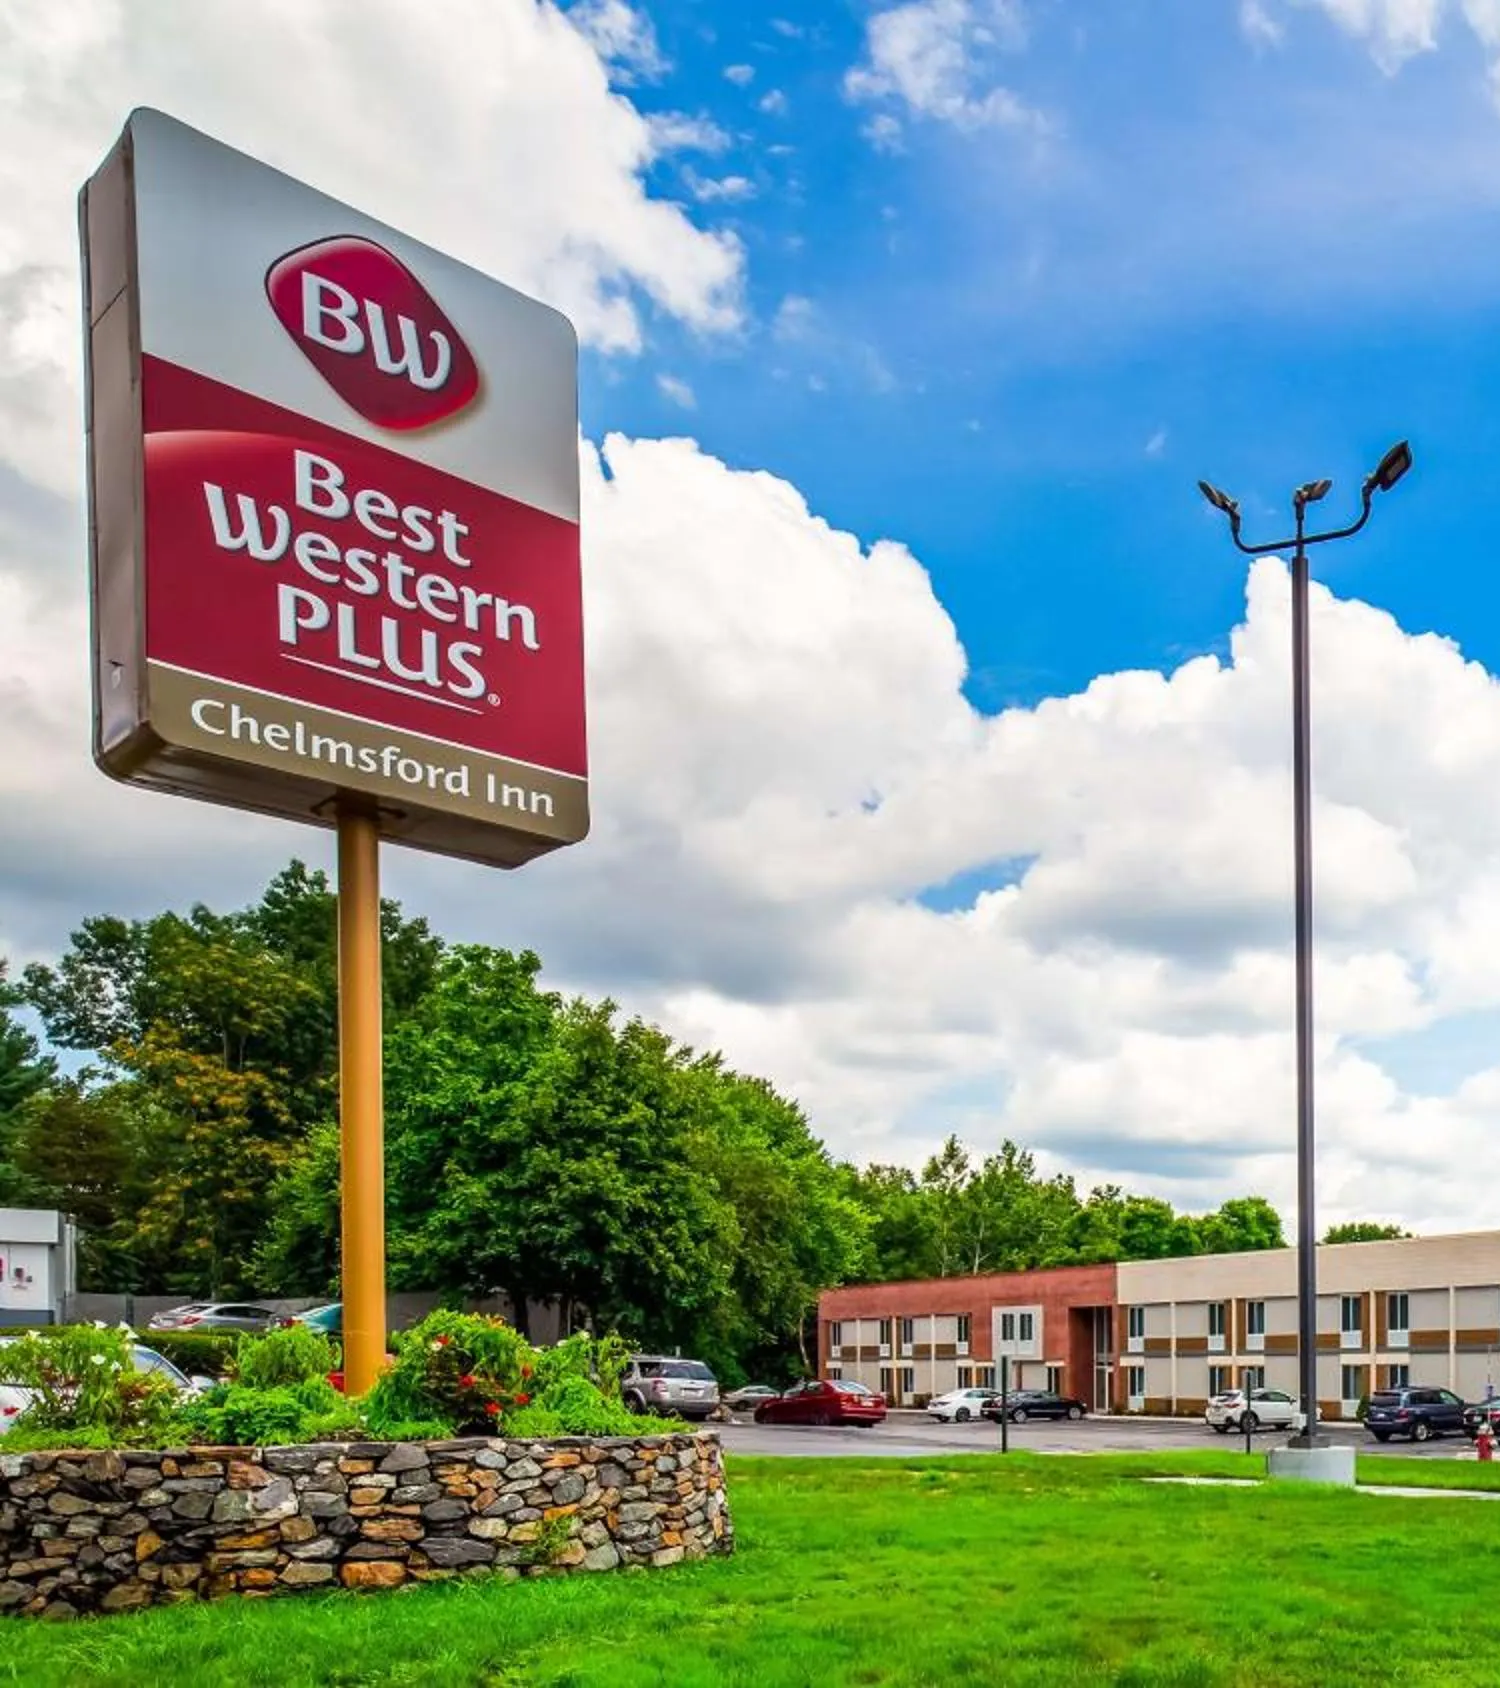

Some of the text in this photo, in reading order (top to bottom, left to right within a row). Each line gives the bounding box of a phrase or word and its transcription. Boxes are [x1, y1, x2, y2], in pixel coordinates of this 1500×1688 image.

[300, 270, 451, 391] BW
[203, 482, 541, 650] Western
[294, 448, 472, 567] Best
[190, 698, 555, 817] Chelmsford Inn
